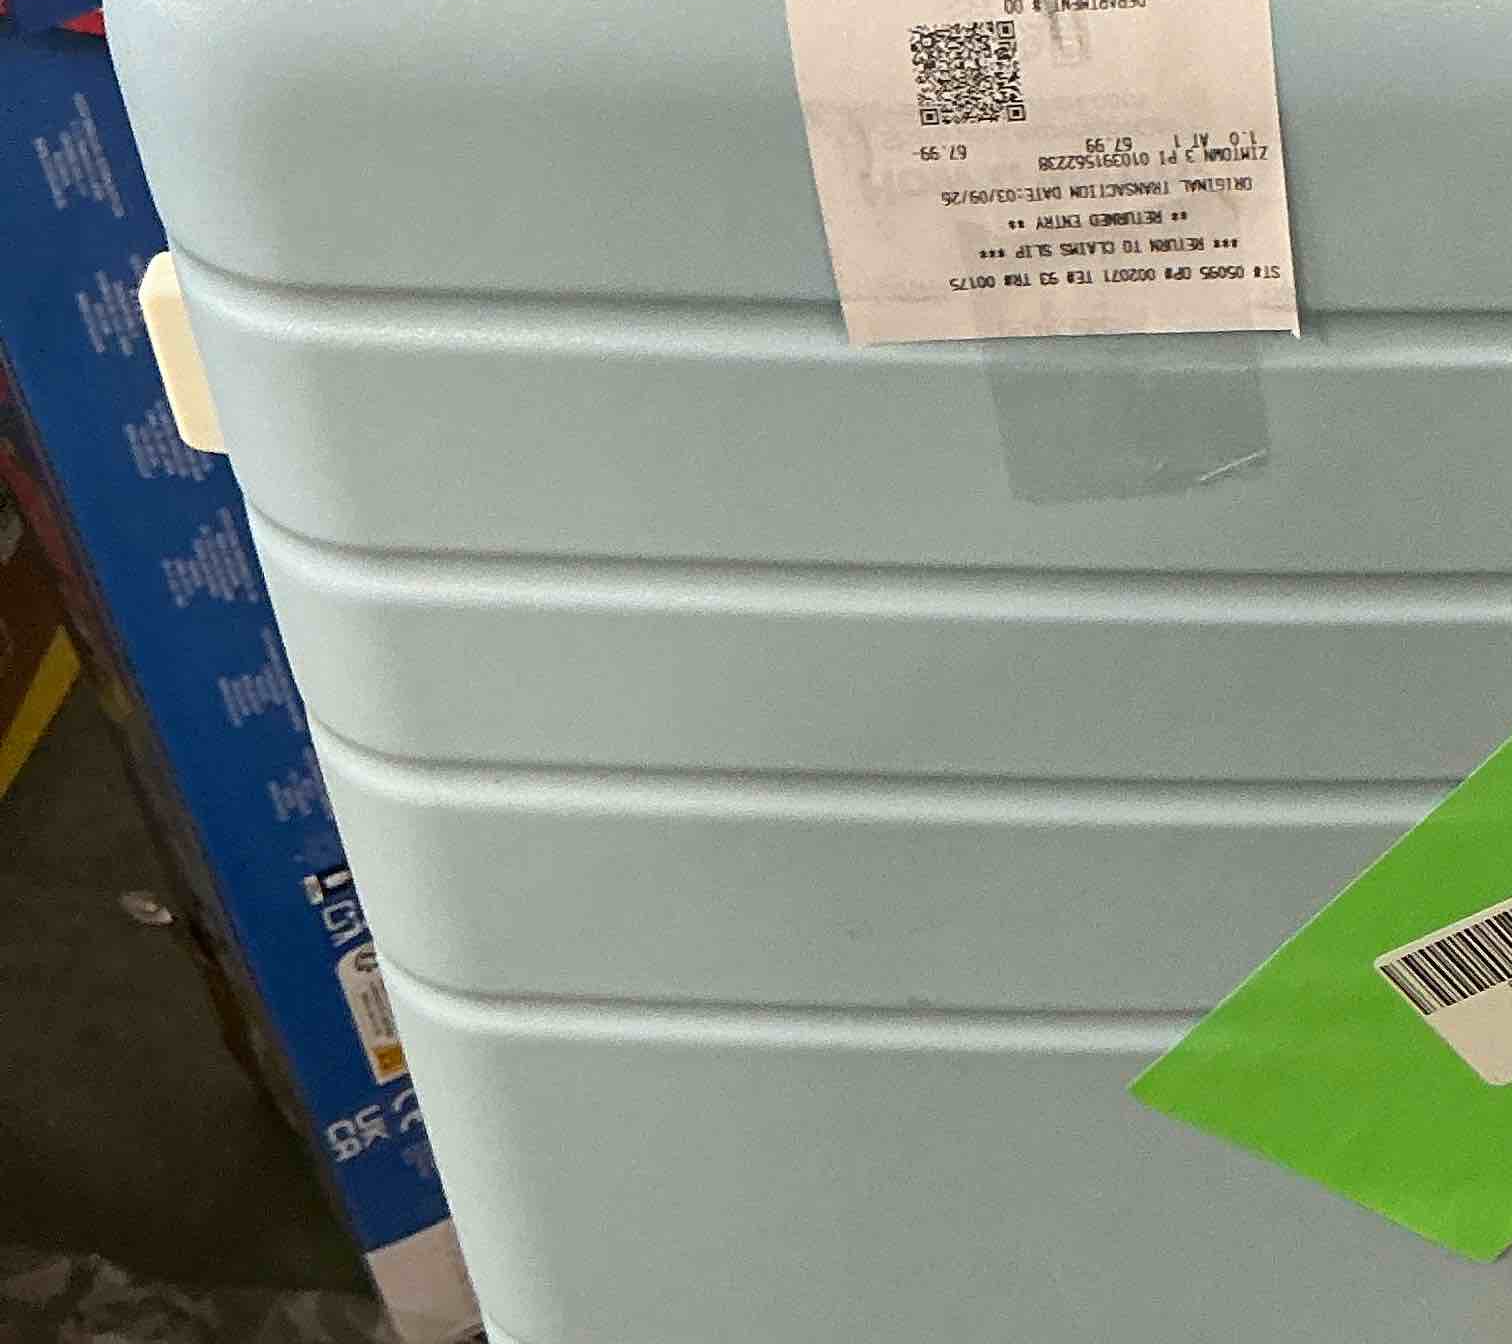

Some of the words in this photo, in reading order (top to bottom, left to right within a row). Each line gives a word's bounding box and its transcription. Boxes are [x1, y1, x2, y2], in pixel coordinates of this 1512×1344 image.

[1086, 137, 1132, 154] 67.99
[1191, 133, 1208, 148] AT
[1159, 150, 1176, 165] PI
[1185, 150, 1198, 163] 3
[1204, 146, 1268, 162] ZIMTOWN
[1070, 181, 1169, 200] TRANSACTION
[1179, 177, 1253, 192] ORIGINAL
[1036, 214, 1080, 230] ENTRY
[1090, 210, 1162, 227] RETURNED
[1016, 244, 1052, 258] SLIP
[1060, 241, 1115, 255] CLAIMS
[1122, 240, 1141, 254] TO
[1150, 238, 1204, 252] RETURN
[1004, 273, 1031, 287] TR#
[1040, 272, 1060, 285] 93
[1067, 270, 1093, 285] TE#
[1164, 268, 1192, 280] OP#
[1200, 266, 1244, 280] 05095
[1254, 266, 1280, 280] ST#
[949, 276, 996, 290] 00175
